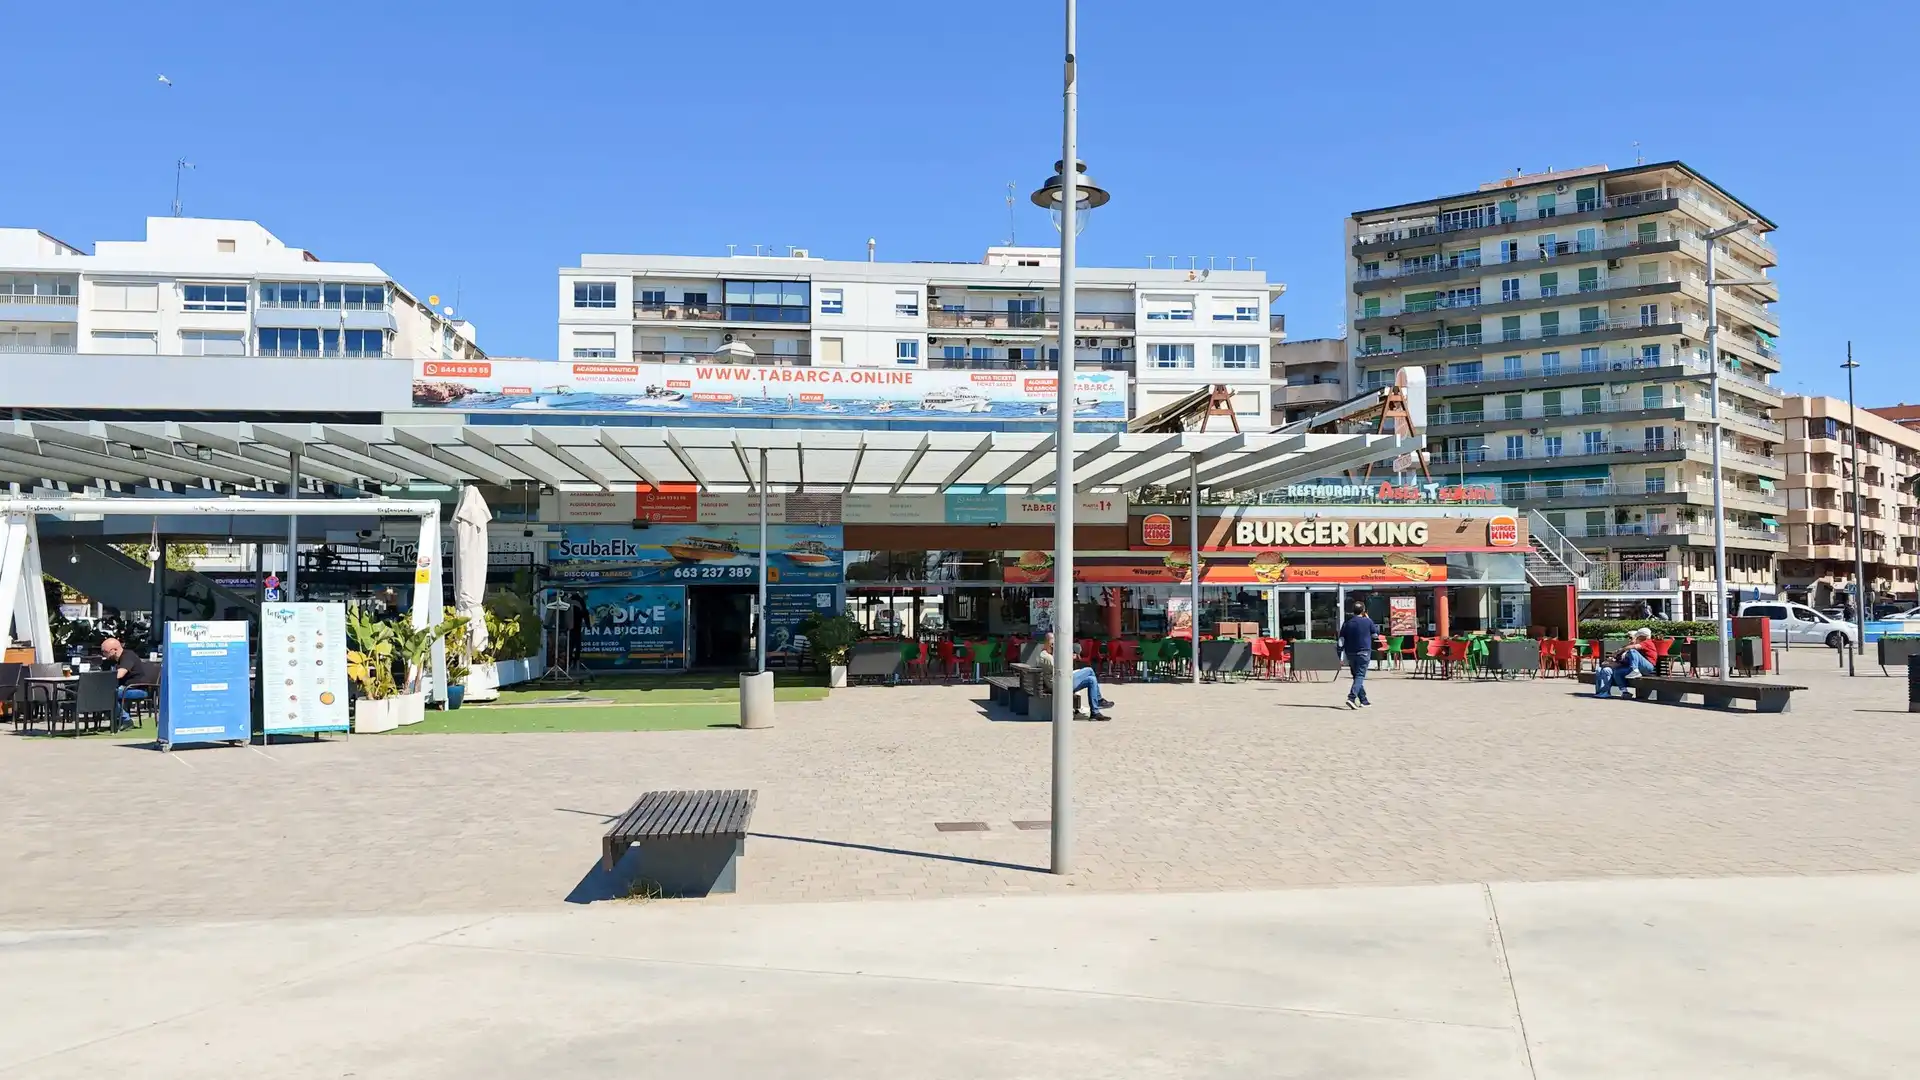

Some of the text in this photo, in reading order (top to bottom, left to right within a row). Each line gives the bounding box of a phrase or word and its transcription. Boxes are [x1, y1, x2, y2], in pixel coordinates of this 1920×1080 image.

[696, 367, 913, 384] WWW.TABARCA.ONLINE
[1287, 484, 1375, 497] RESTAURANTE
[1144, 523, 1171, 531] BURGER
[1490, 524, 1516, 532] BURGER
[1144, 530, 1171, 540] KING
[1236, 520, 1429, 545] BURGER KING
[1490, 531, 1517, 540] KING
[559, 538, 637, 557] ScubaElx
[673, 566, 752, 579] 663 237 389
[1293, 569, 1320, 577] Big King
[1370, 568, 1386, 576] Long
[612, 605, 666, 624] DIVE
[602, 626, 612, 636] A
